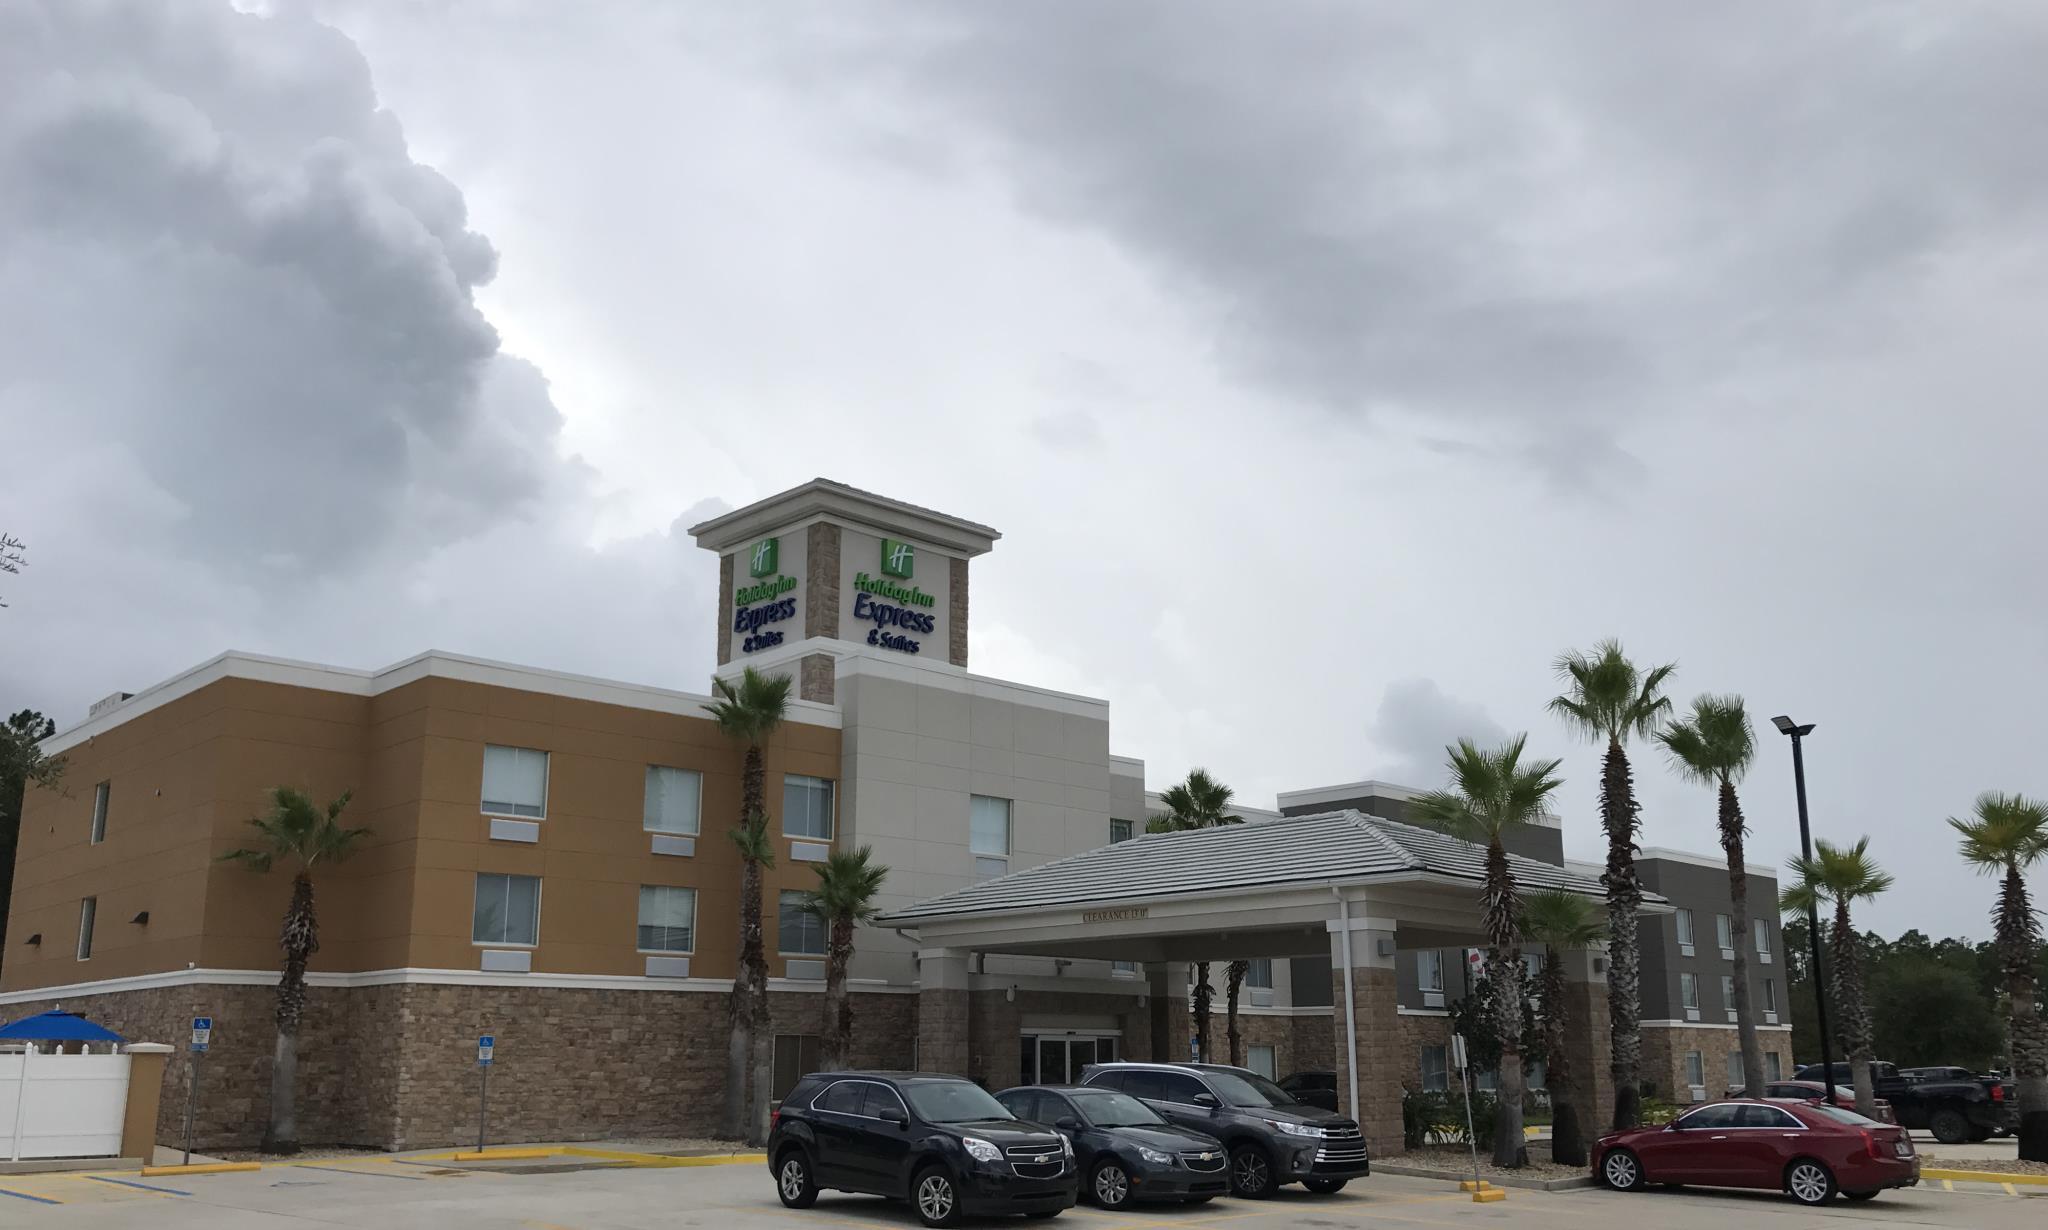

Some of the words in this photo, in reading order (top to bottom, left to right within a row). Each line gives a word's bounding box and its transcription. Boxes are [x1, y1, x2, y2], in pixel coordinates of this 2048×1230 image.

[735, 582, 778, 607] Holiday
[776, 574, 798, 594] Inn
[853, 571, 912, 606] Holiday
[910, 586, 936, 608] Inn
[734, 597, 797, 634] Express
[853, 592, 936, 634] Express
[742, 636, 754, 653] &
[753, 631, 785, 651] Suites
[867, 629, 879, 646] &
[879, 631, 920, 654] Suites
[1082, 910, 1129, 922] CLEARANCE
